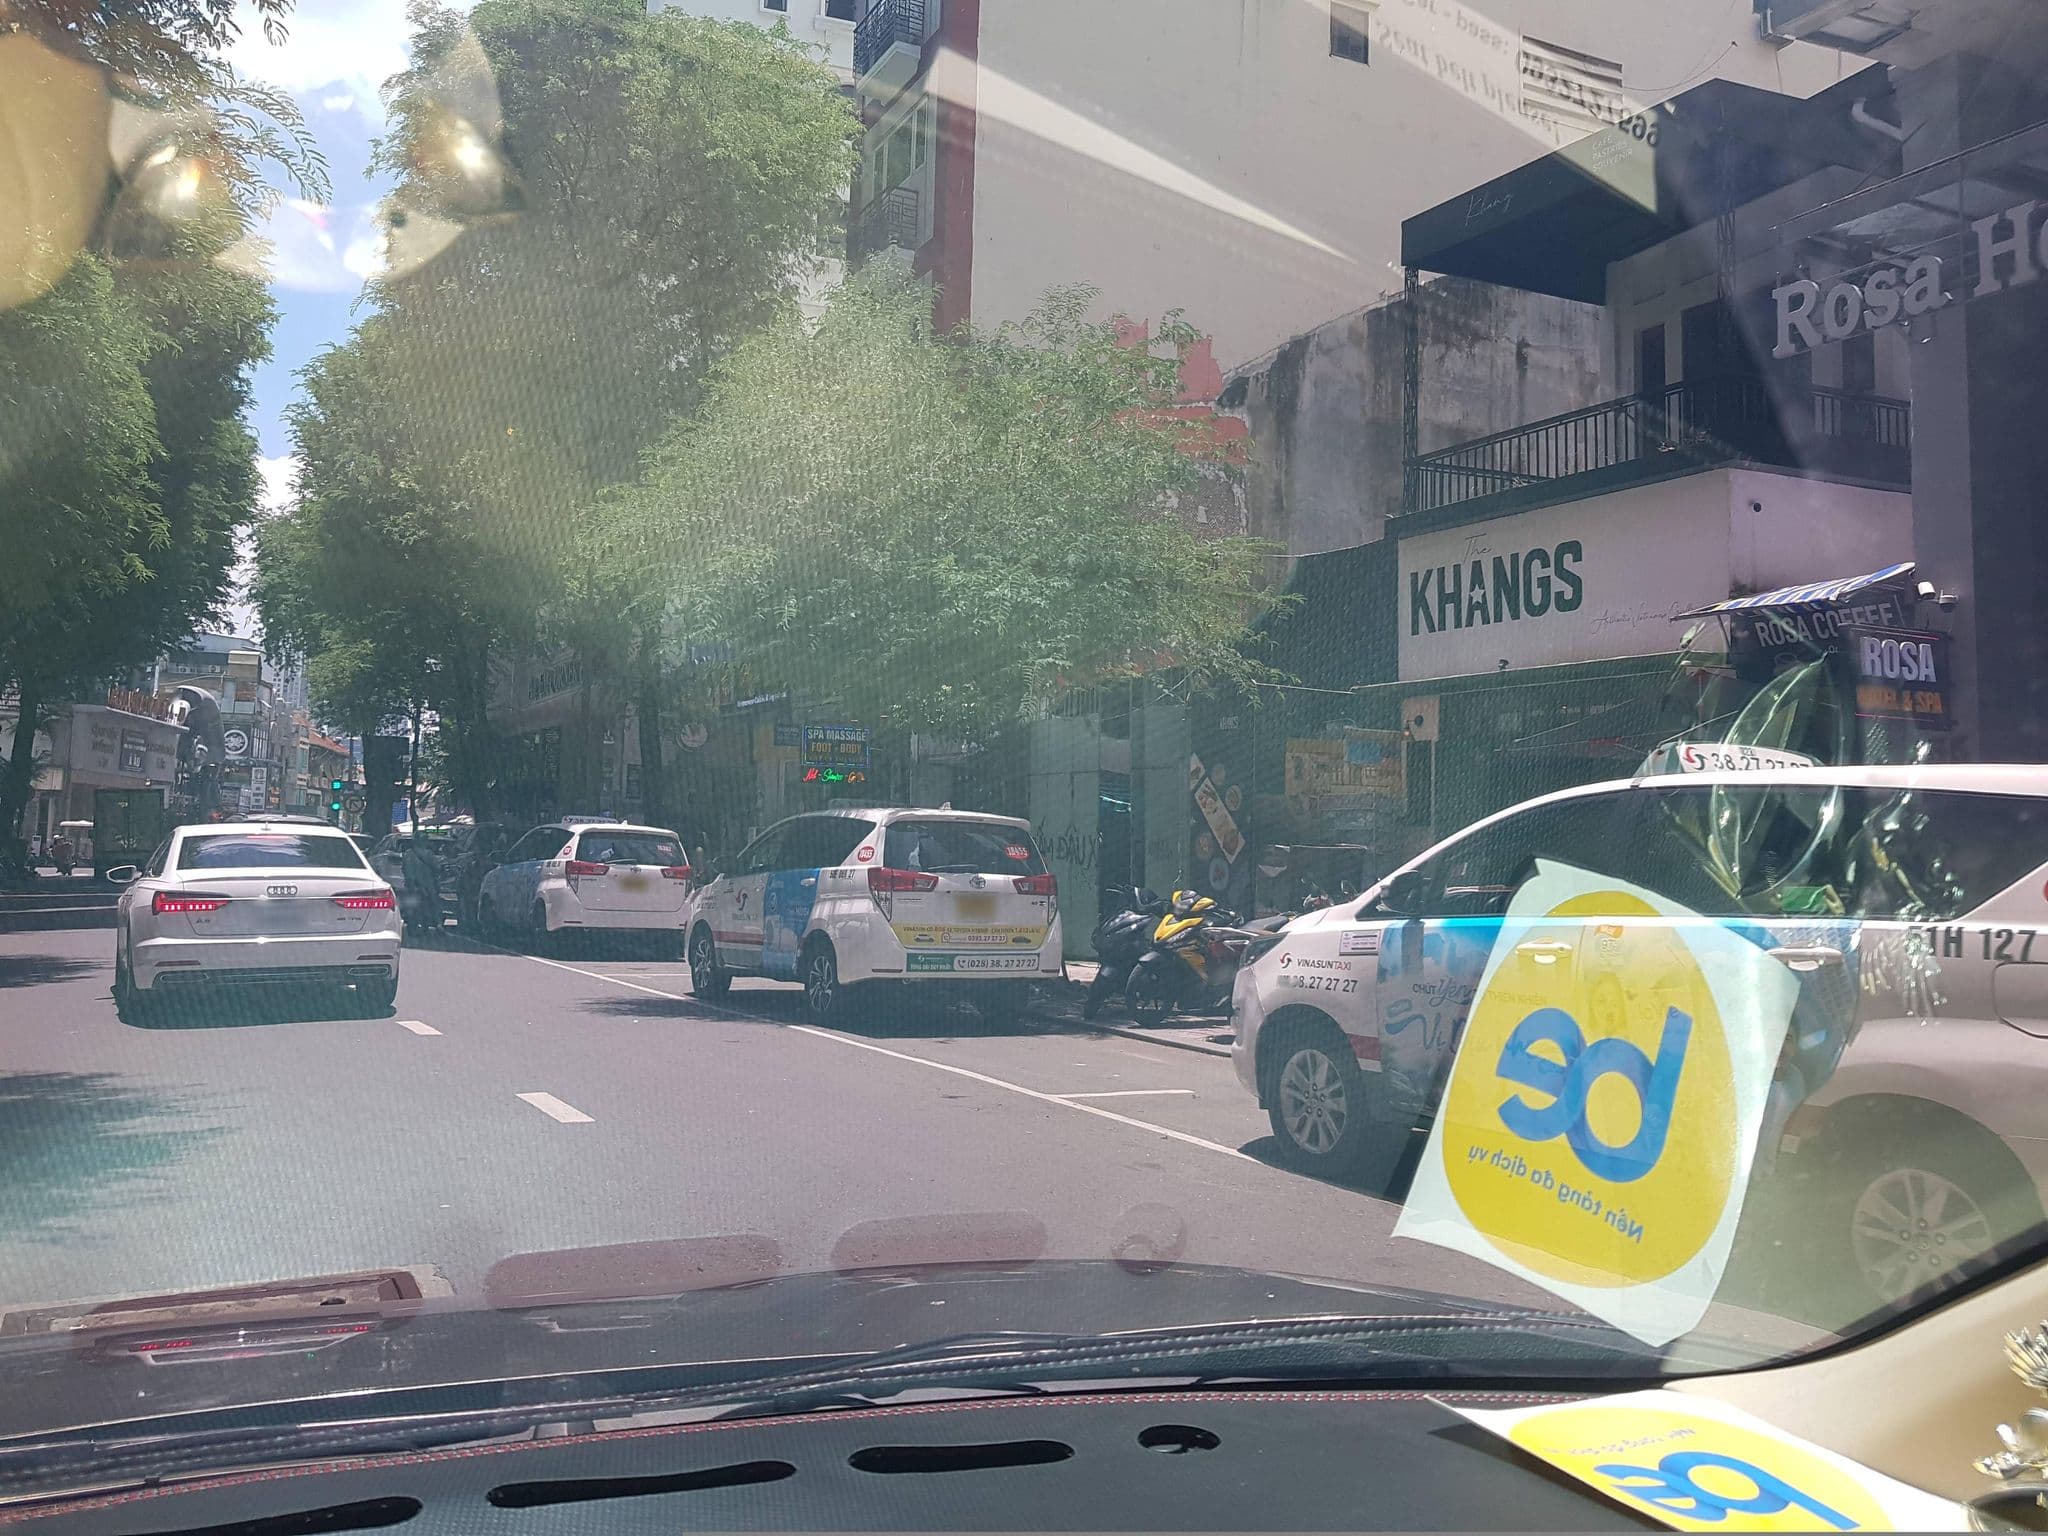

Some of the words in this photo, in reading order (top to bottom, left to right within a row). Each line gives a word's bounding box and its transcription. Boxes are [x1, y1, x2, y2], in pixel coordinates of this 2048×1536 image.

[1771, 254, 1954, 359] Rosa
[1972, 200, 2048, 298] H
[1461, 533, 1495, 564] The
[1409, 539, 1583, 637] KHANGS
[1754, 614, 1812, 648] ROSA
[1812, 601, 1895, 641] COFFEE
[1859, 636, 1938, 684] ROSA
[1917, 691, 1943, 714] SPA
[807, 728, 825, 740] SPA
[826, 729, 866, 743] MASSAGE
[811, 741, 833, 753] FOOT
[840, 743, 862, 754] BODY
[1979, 928, 2037, 961] 127
[967, 959, 989, 969] (028)
[1297, 957, 1352, 972] VINASUNTAXI
[1324, 976, 1341, 992] 27
[1341, 978, 1359, 993] 27
